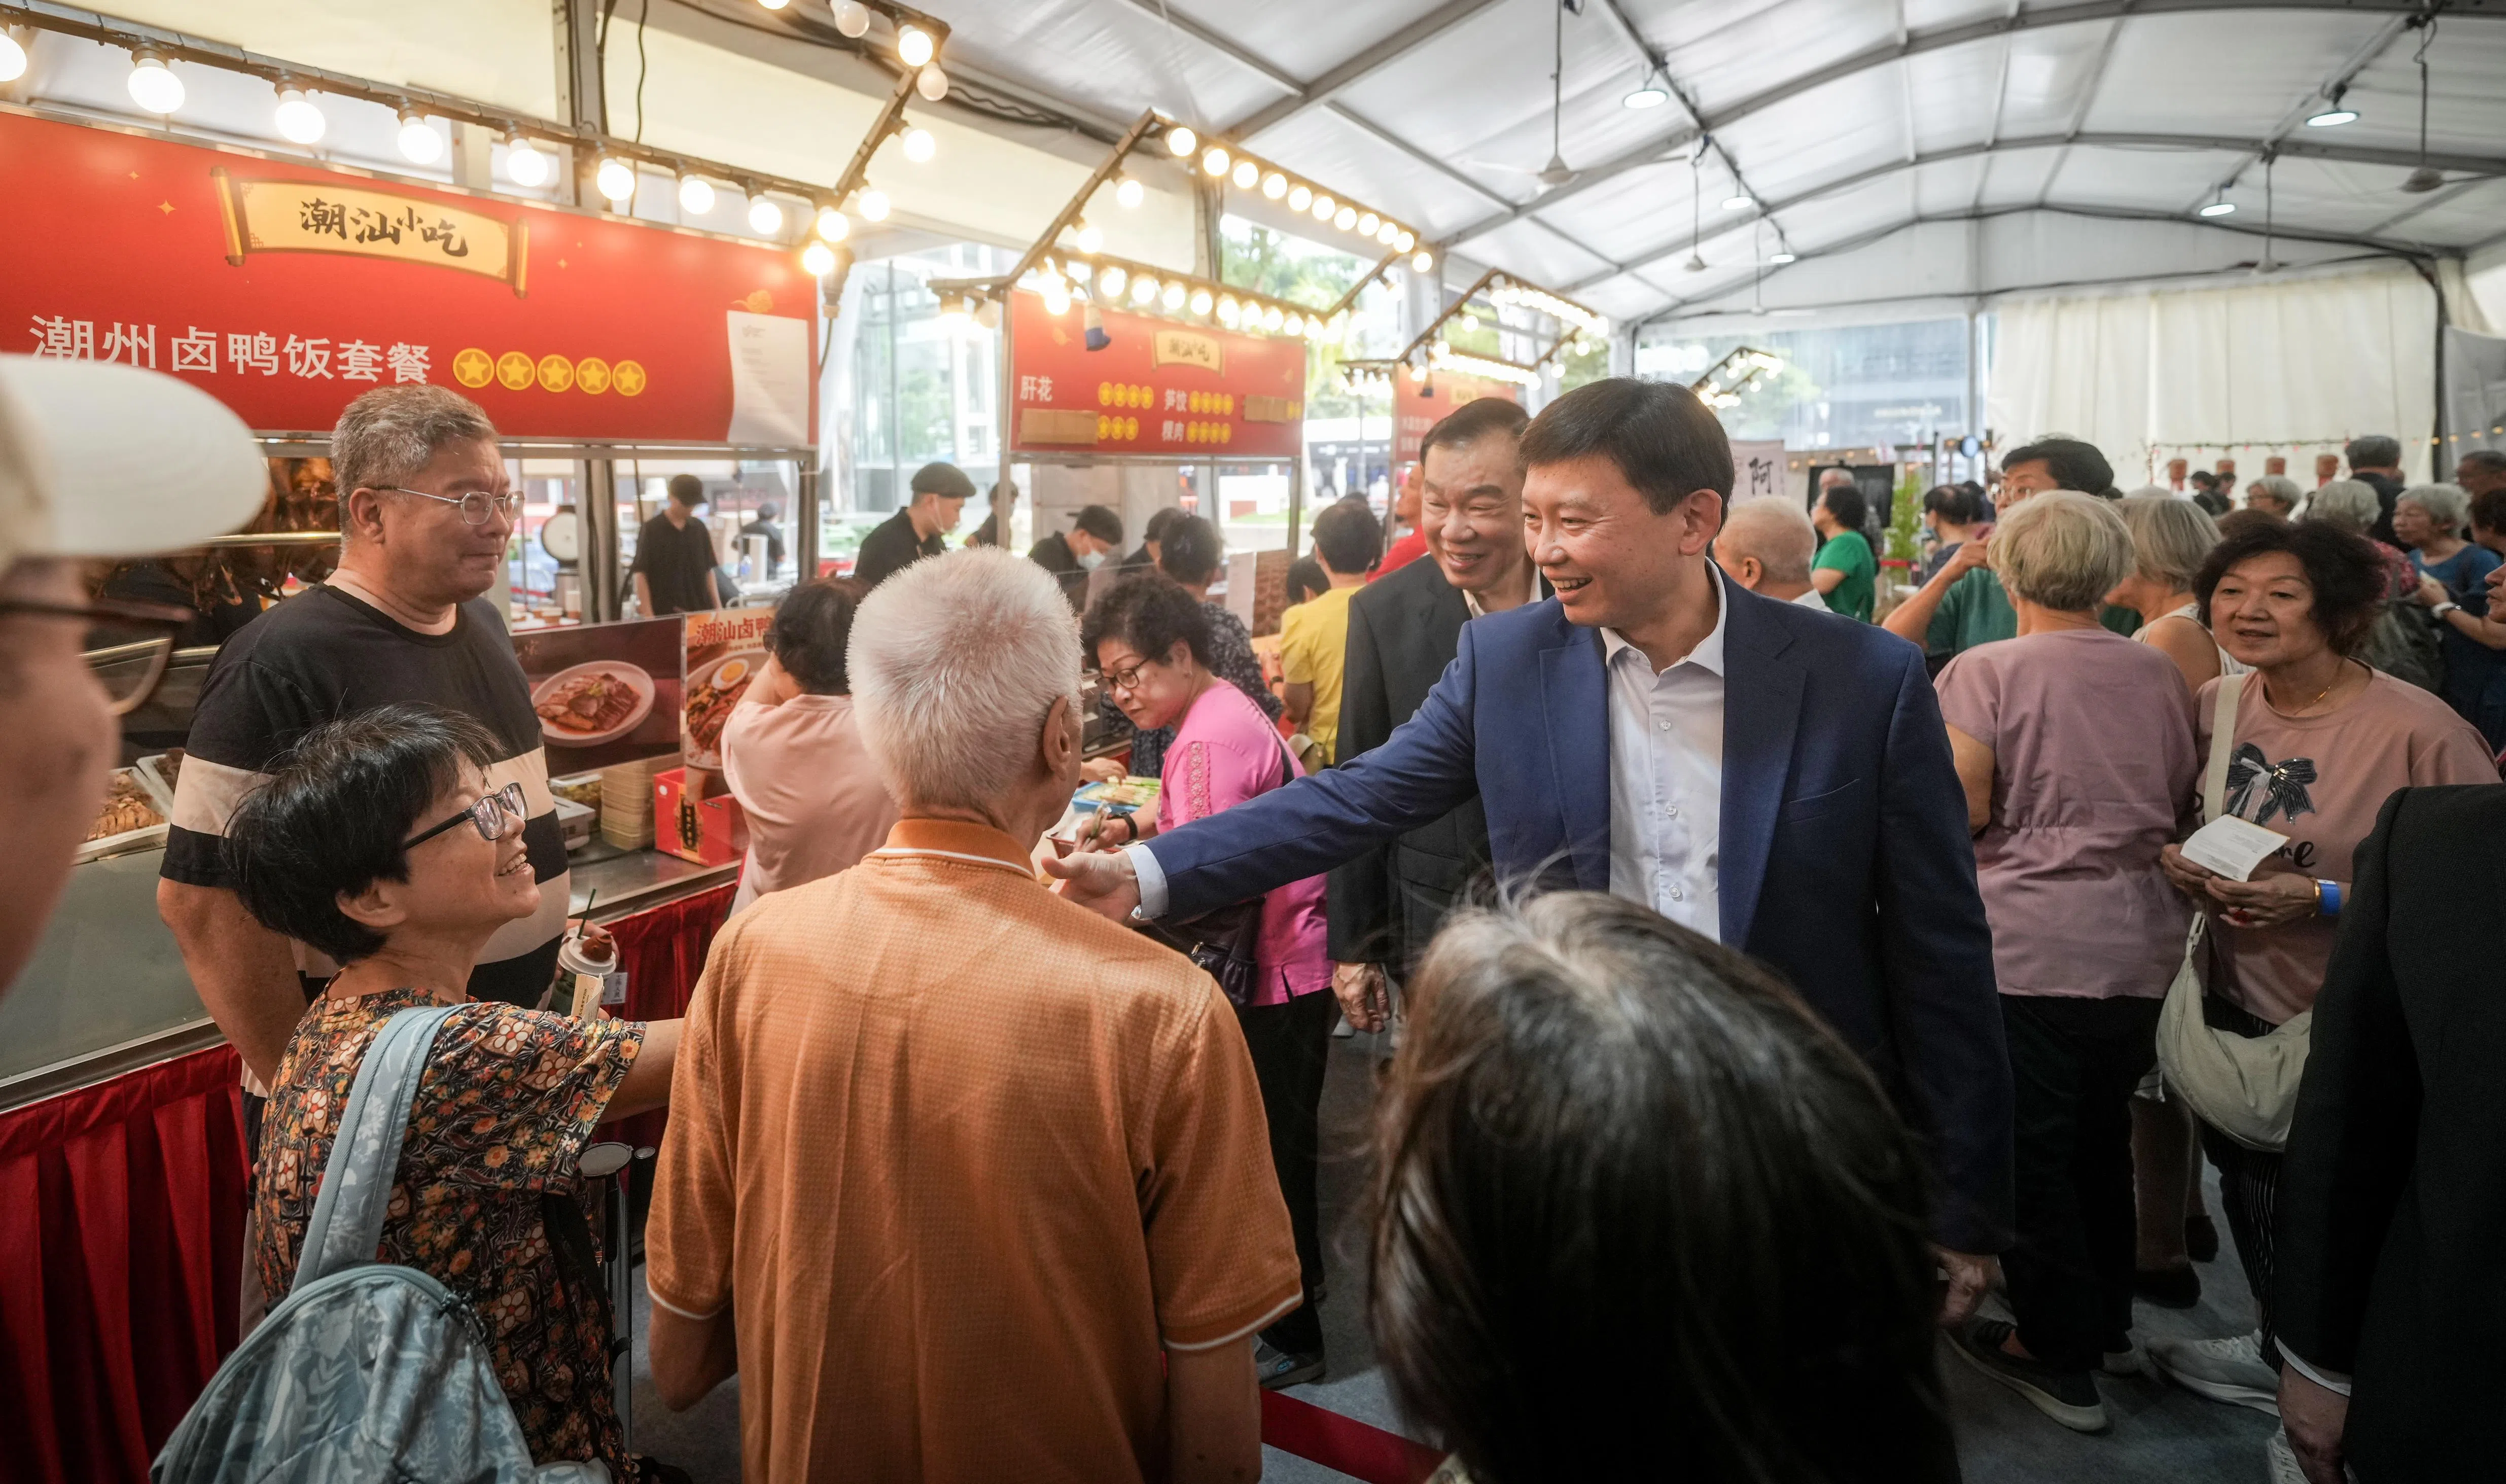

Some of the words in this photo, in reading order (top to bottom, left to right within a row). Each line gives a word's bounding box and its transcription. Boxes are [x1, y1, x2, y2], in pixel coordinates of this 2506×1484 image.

[299, 197, 468, 257] 潮汕小吃
[29, 314, 432, 384] 潮州卤鸭饭套餐
[1019, 375, 1053, 402] 肝花
[1748, 457, 1773, 494] 阿
